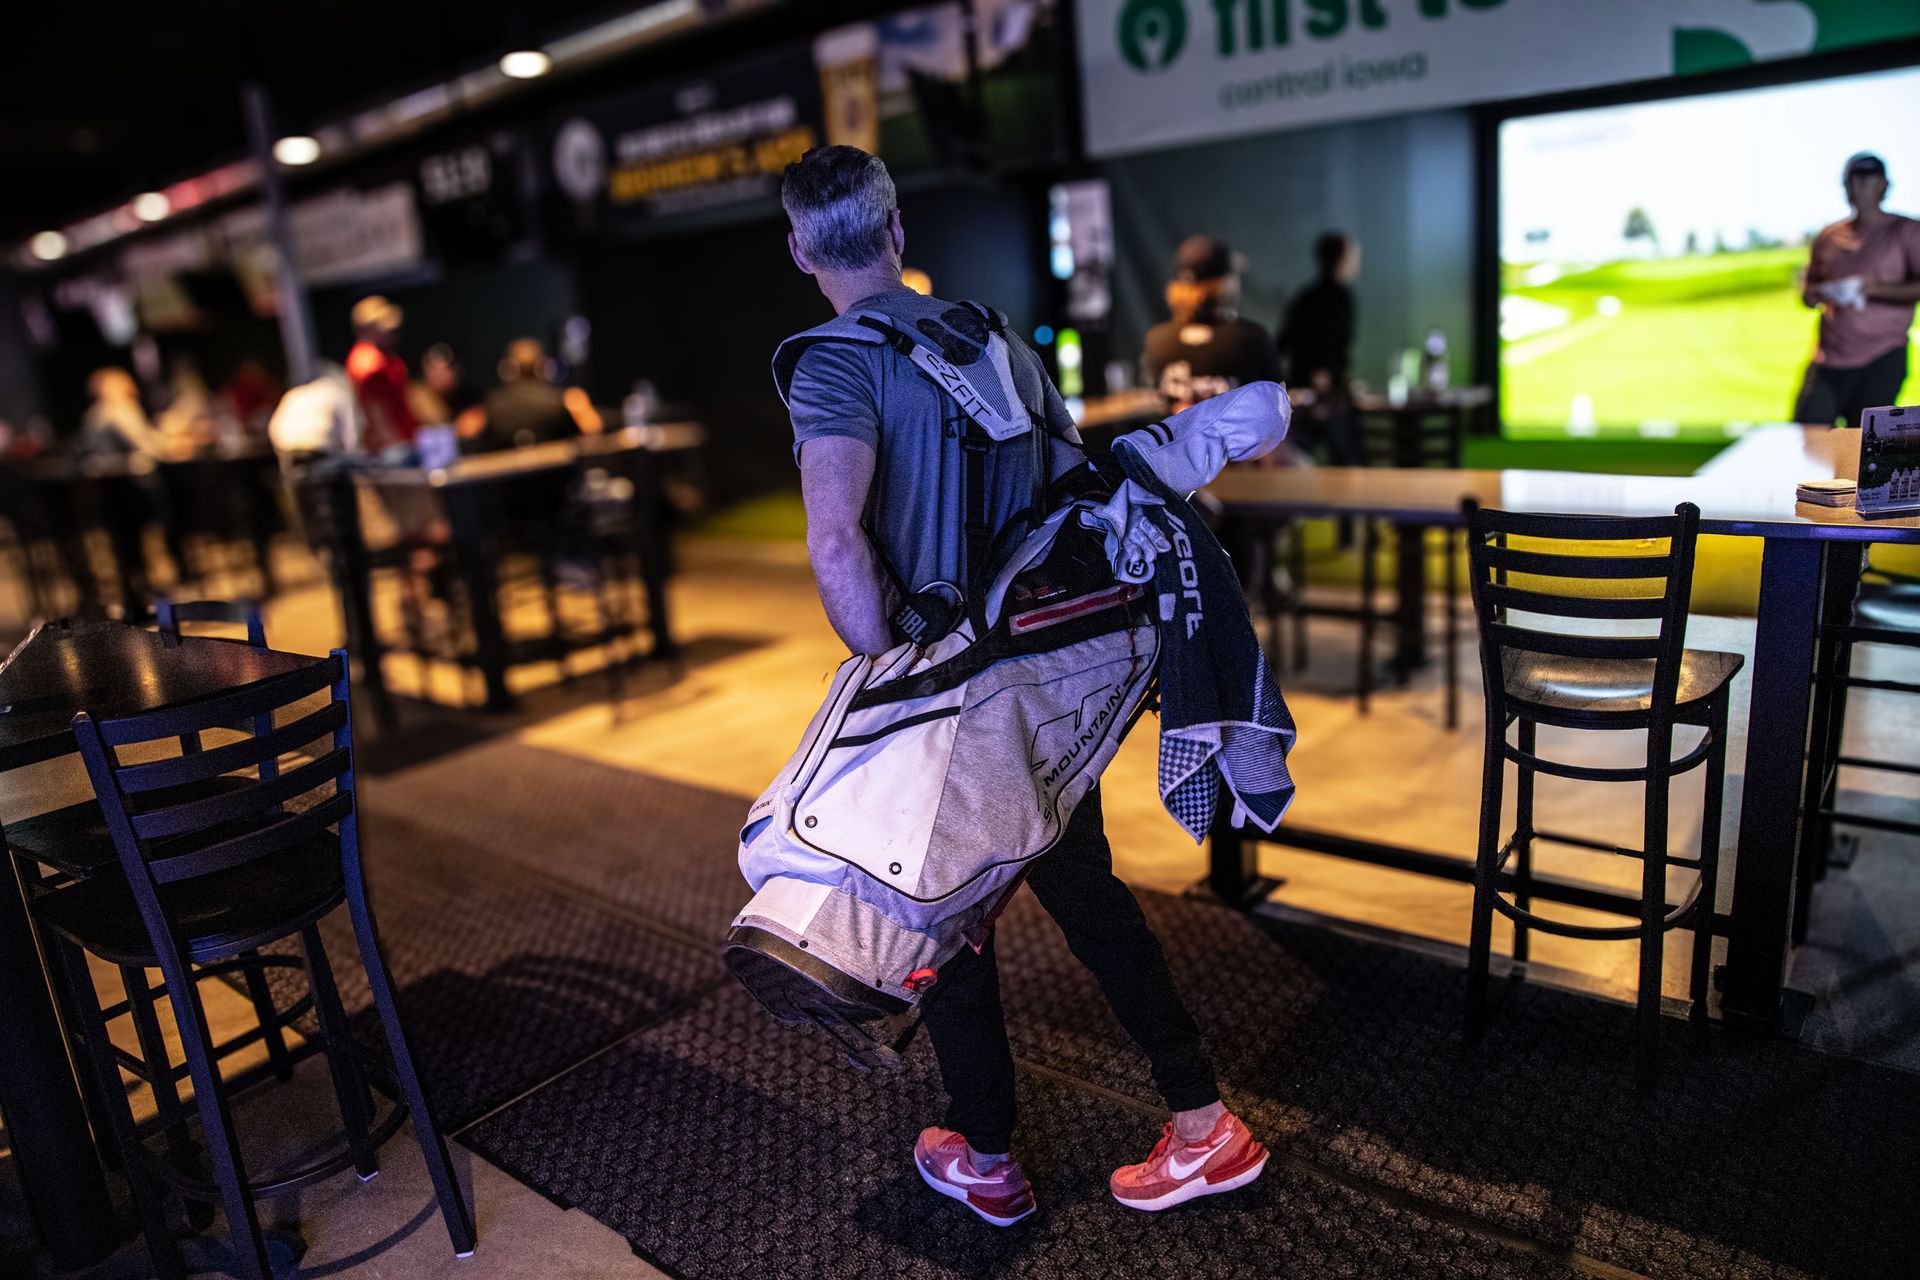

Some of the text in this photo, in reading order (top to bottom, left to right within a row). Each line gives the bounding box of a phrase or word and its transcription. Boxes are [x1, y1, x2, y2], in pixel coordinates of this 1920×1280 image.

[1218, 51, 1428, 110] central iowa
[896, 604, 928, 644] JBL
[1043, 688, 1121, 788] MOUNTAIN
